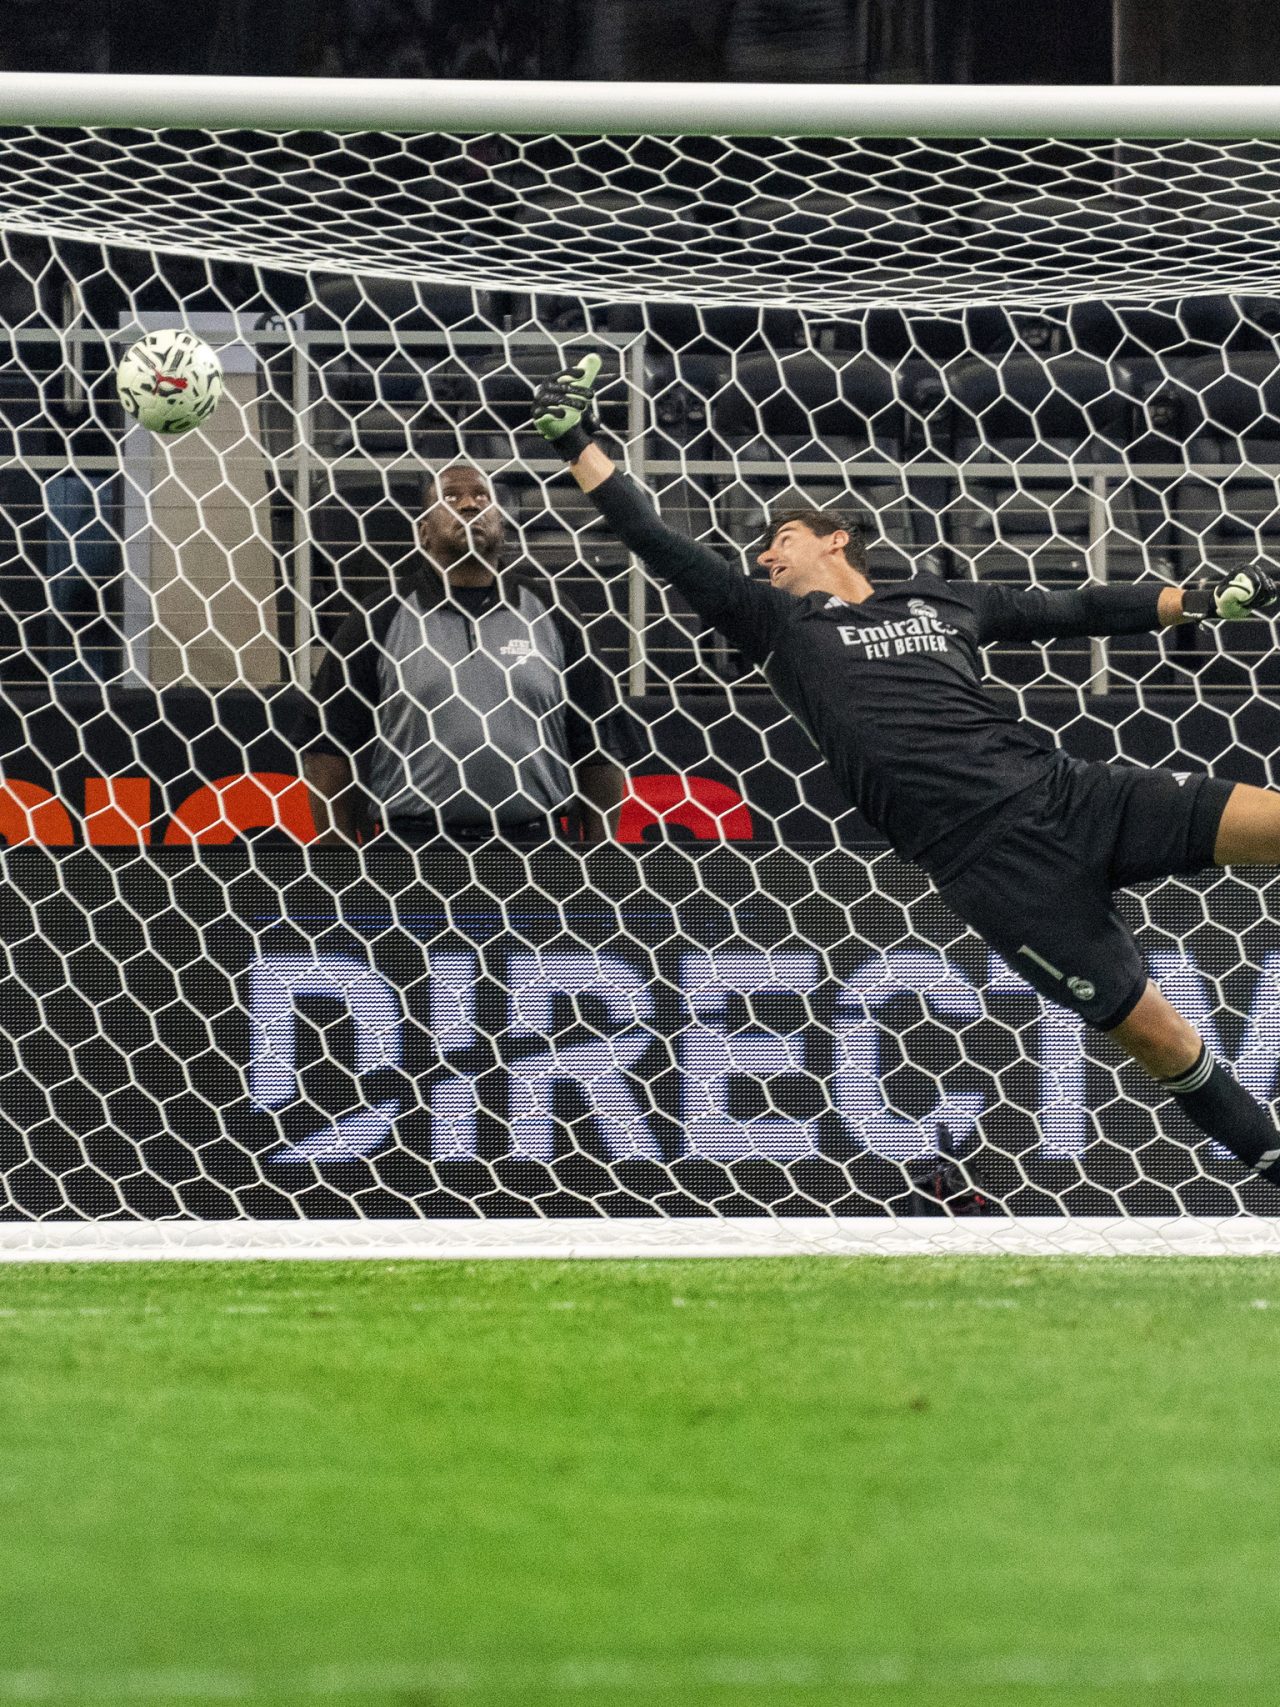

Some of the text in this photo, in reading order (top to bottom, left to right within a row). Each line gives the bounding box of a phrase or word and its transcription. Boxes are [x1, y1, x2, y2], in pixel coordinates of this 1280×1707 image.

[864, 635, 948, 660] FLY BETTER
[1016, 944, 1064, 980] 1
